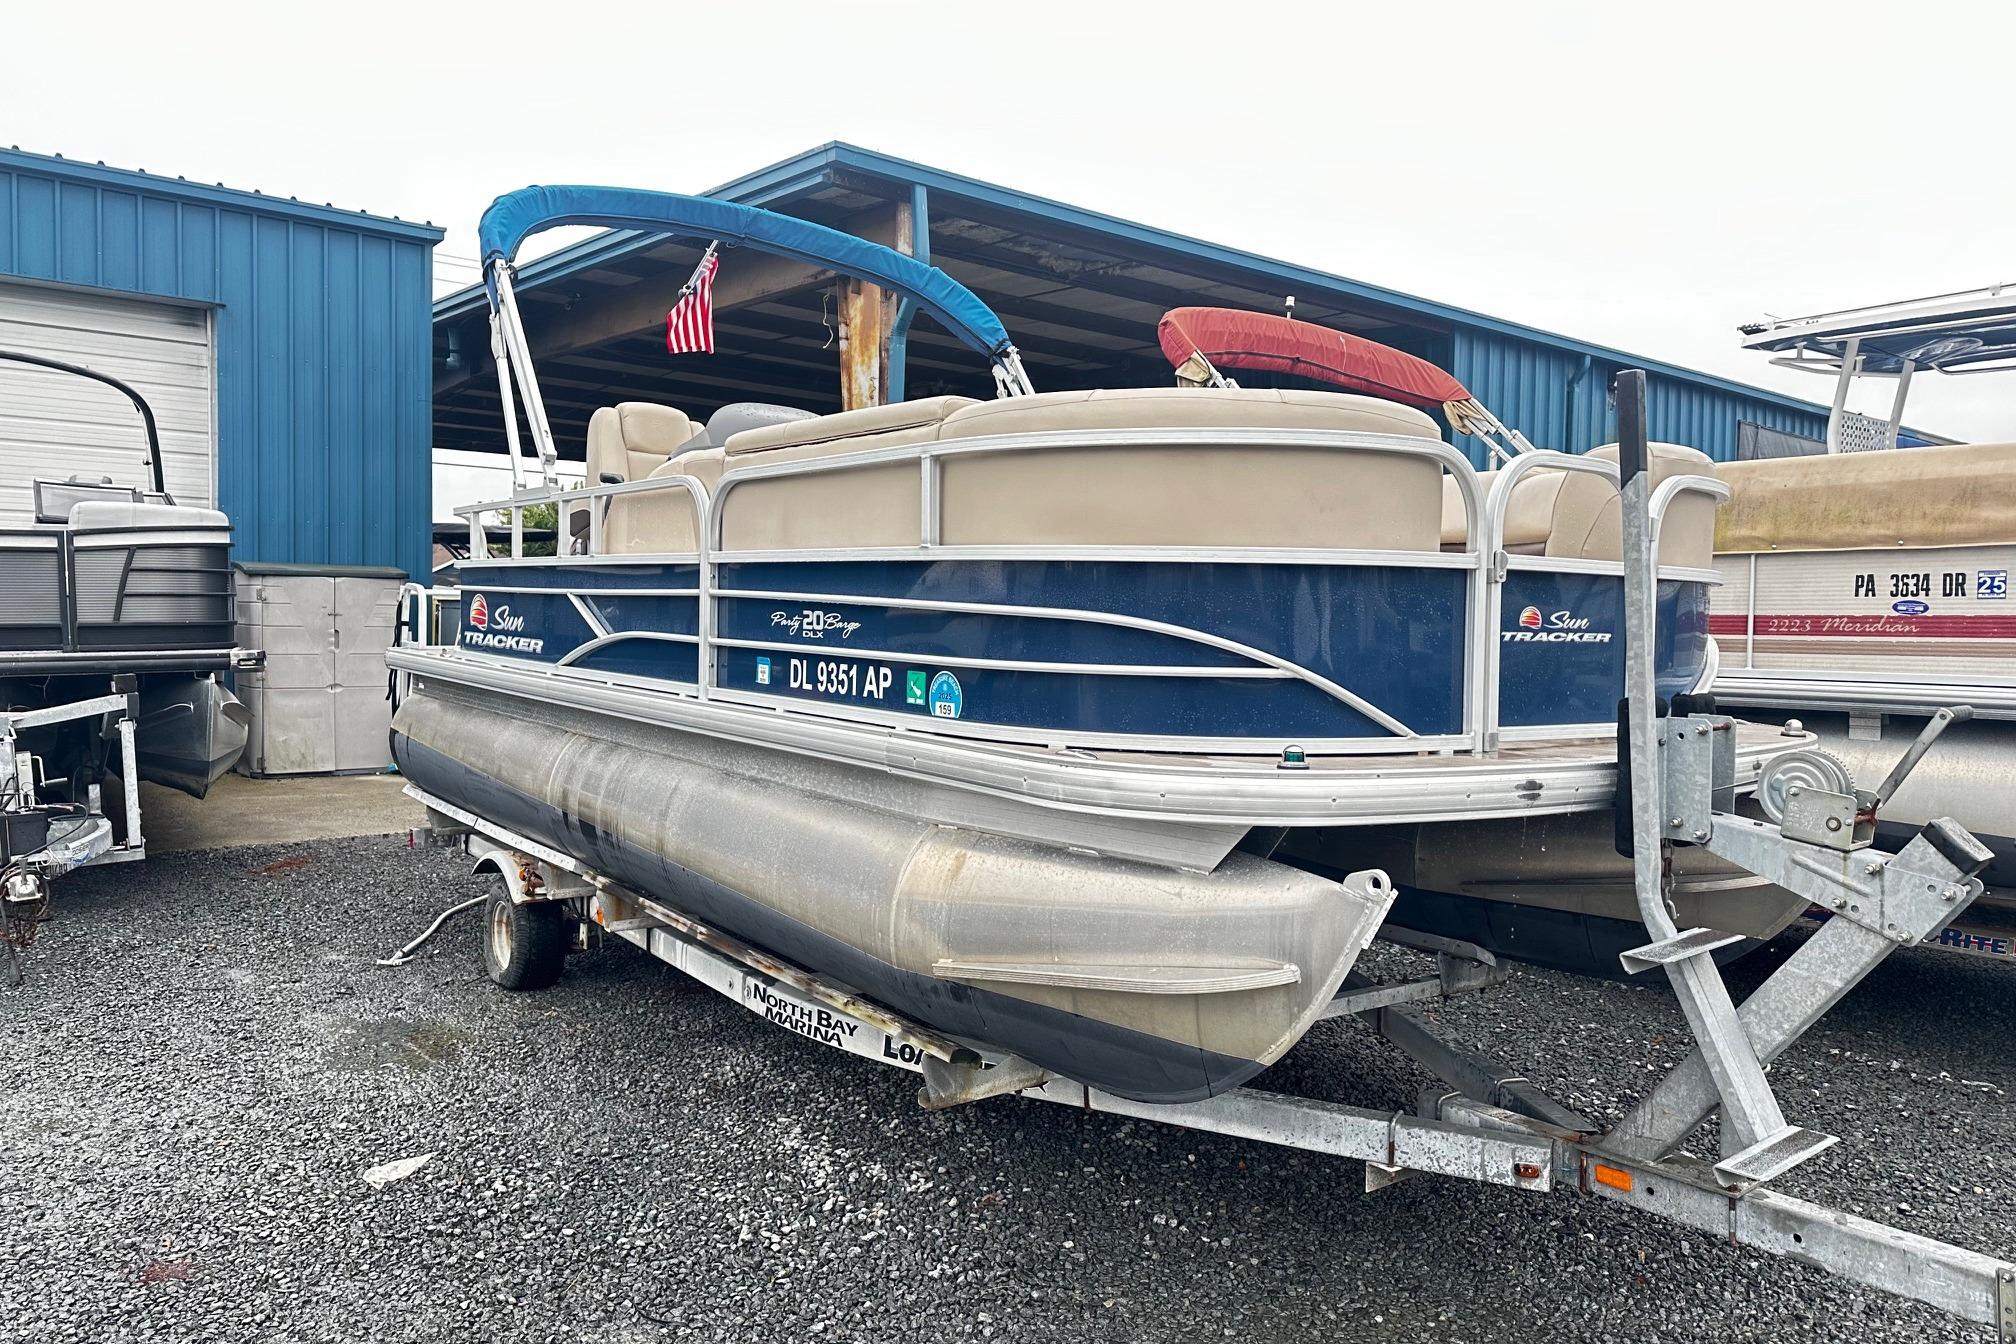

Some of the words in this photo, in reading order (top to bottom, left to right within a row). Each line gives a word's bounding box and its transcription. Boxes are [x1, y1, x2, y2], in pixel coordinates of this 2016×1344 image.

[1854, 574, 1877, 598] PA
[1889, 573, 1931, 598] 3634
[1942, 572, 1967, 597] DR
[1978, 577, 2006, 594] 25
[489, 605, 525, 632] Sun
[770, 611, 803, 635] Party
[802, 610, 824, 630] 20
[823, 613, 862, 639] Barge
[1543, 611, 1590, 630] Sun
[1767, 619, 1812, 633] 2223
[1820, 614, 1921, 633] Meridian
[464, 631, 544, 653] TRACKER
[802, 630, 824, 639] DLX
[1500, 631, 1612, 643] TRACKER
[789, 658, 813, 691] DL
[817, 660, 857, 696] 9351
[862, 665, 893, 700] AP
[938, 703, 952, 715] 159
[1938, 927, 2009, 956] RITE
[753, 983, 812, 1022] NORTH
[816, 1008, 859, 1038] BAY
[764, 1007, 844, 1048] MARINA
[883, 1034, 924, 1065] LO
